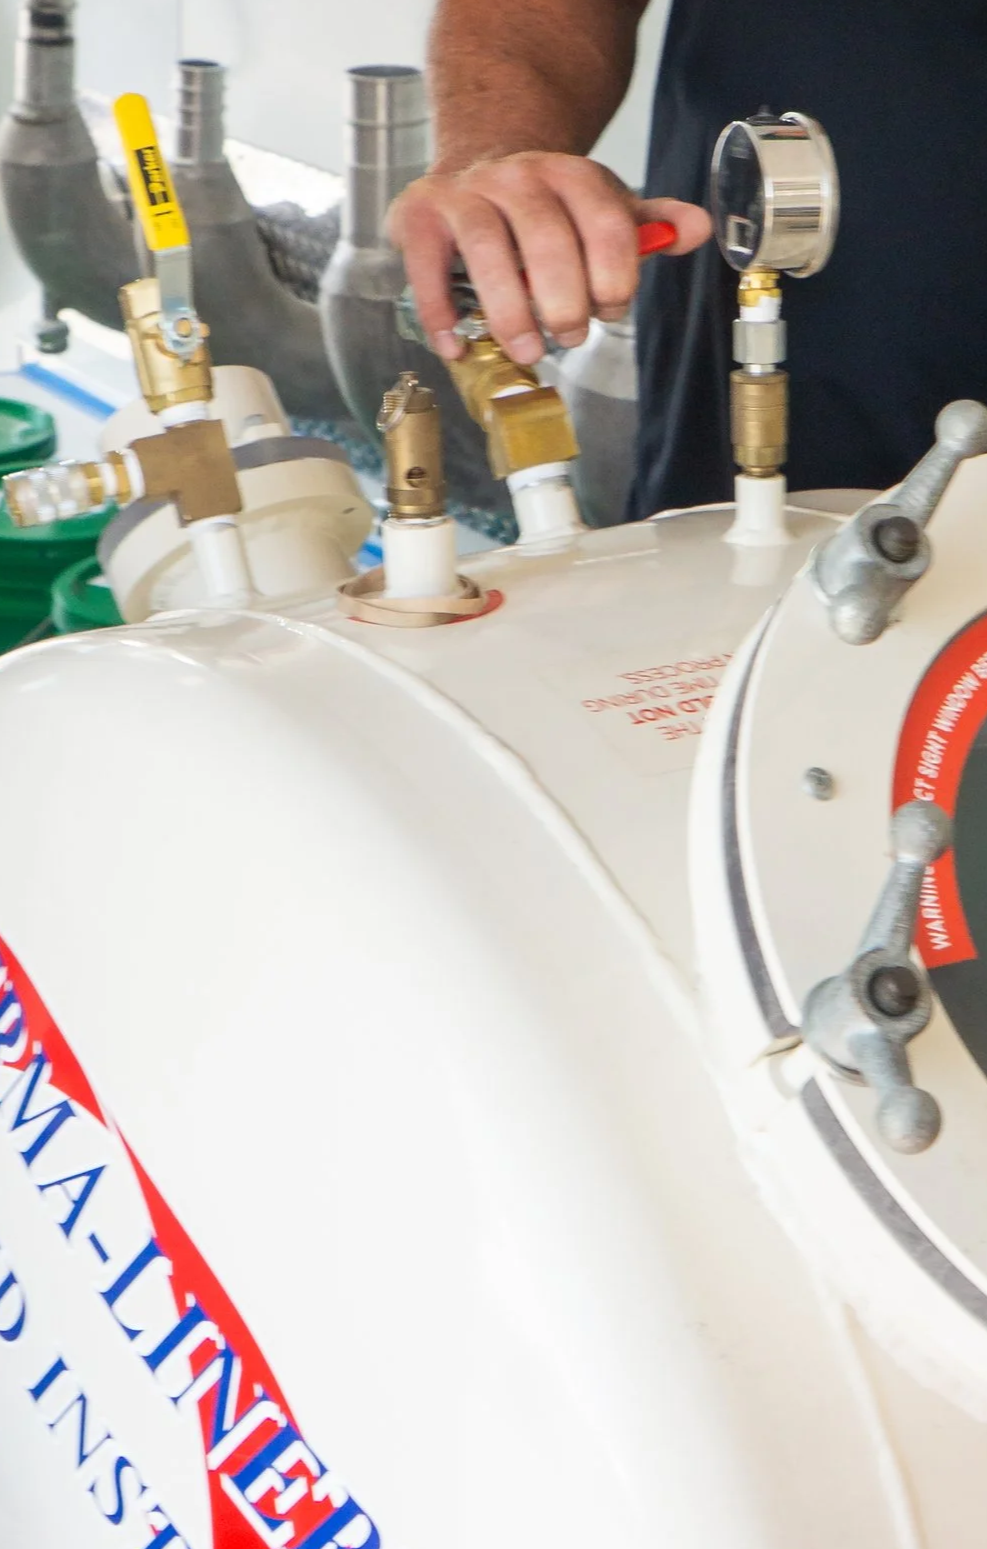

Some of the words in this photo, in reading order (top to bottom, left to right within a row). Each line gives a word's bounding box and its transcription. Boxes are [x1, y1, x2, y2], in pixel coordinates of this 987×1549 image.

[625, 704, 679, 725] NOT
[932, 671, 982, 733] WINDOW
[917, 730, 948, 779] SIGHT
